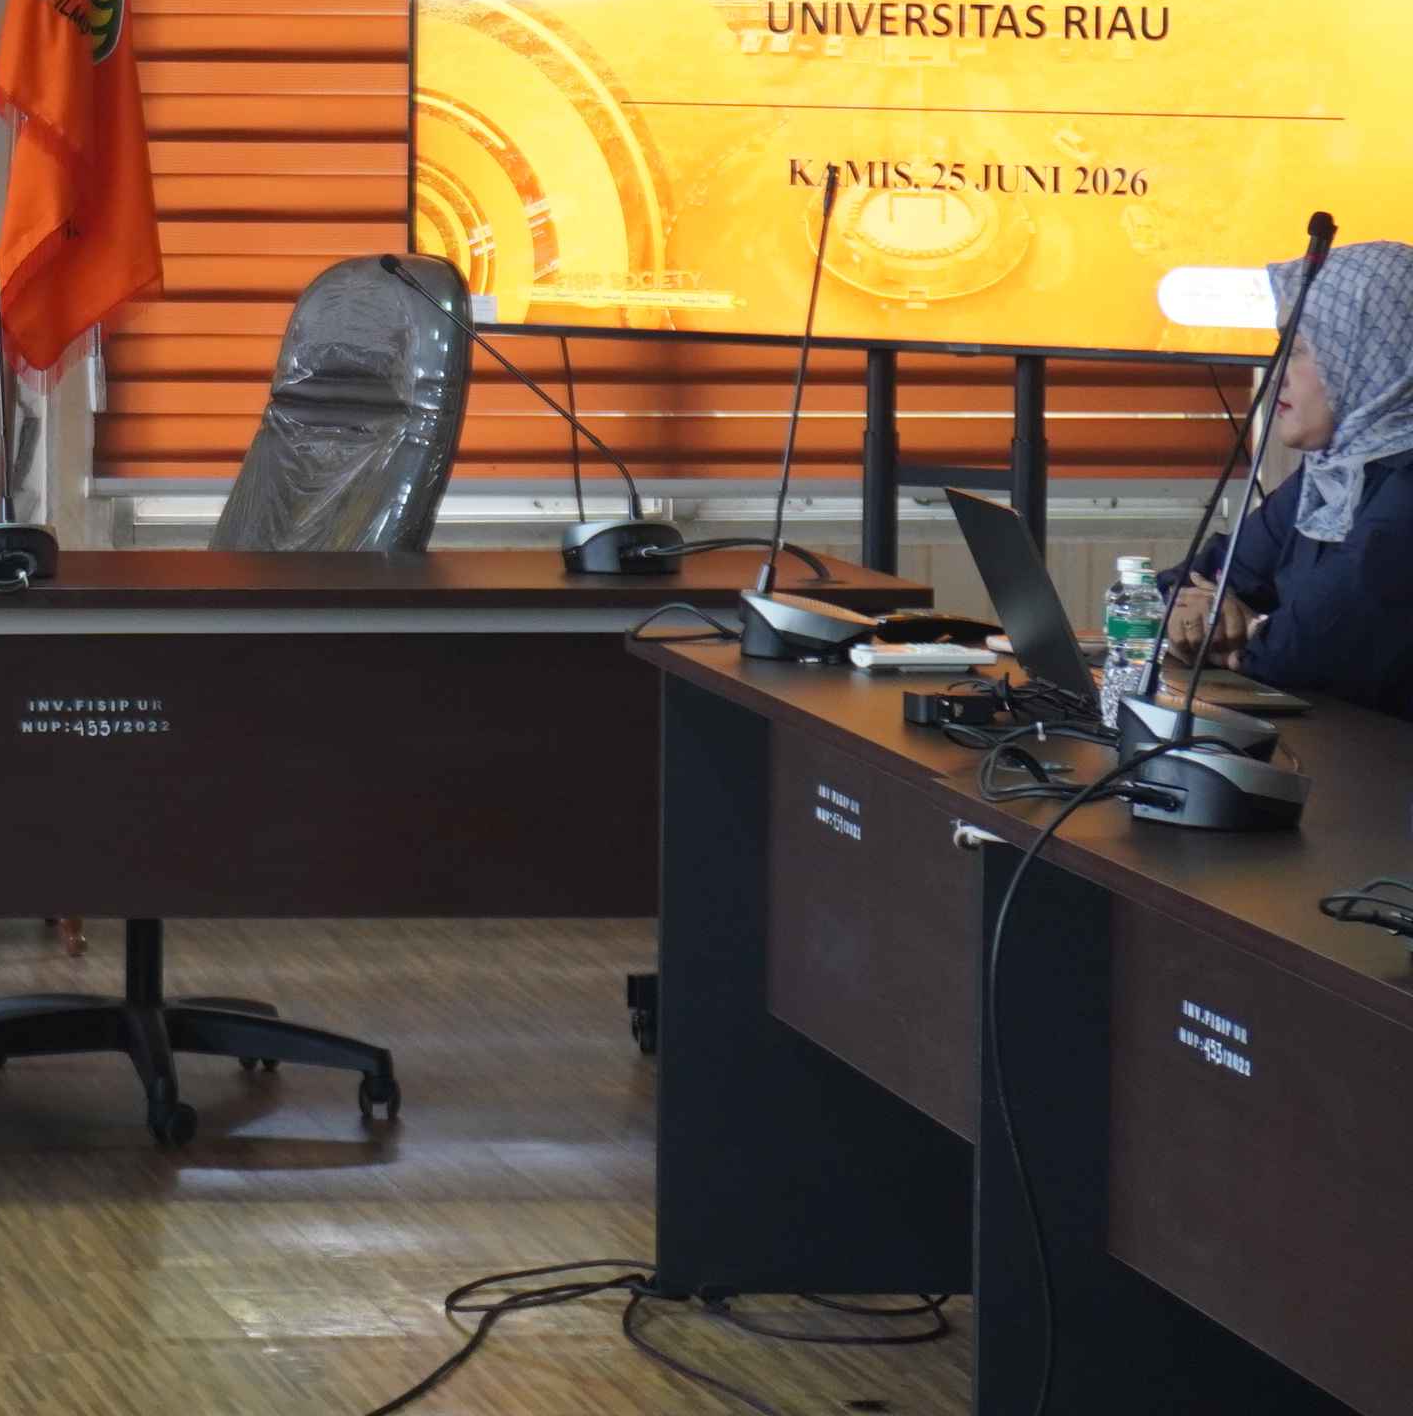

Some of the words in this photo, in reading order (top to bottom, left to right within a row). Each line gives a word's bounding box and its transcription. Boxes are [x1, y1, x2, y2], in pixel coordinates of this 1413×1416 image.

[767, 1, 1048, 40] UNIVERSITAS
[1063, 5, 1170, 41] RIAU
[932, 162, 967, 191] 25
[974, 164, 1061, 194] JUNI
[1073, 166, 1149, 196] 2026
